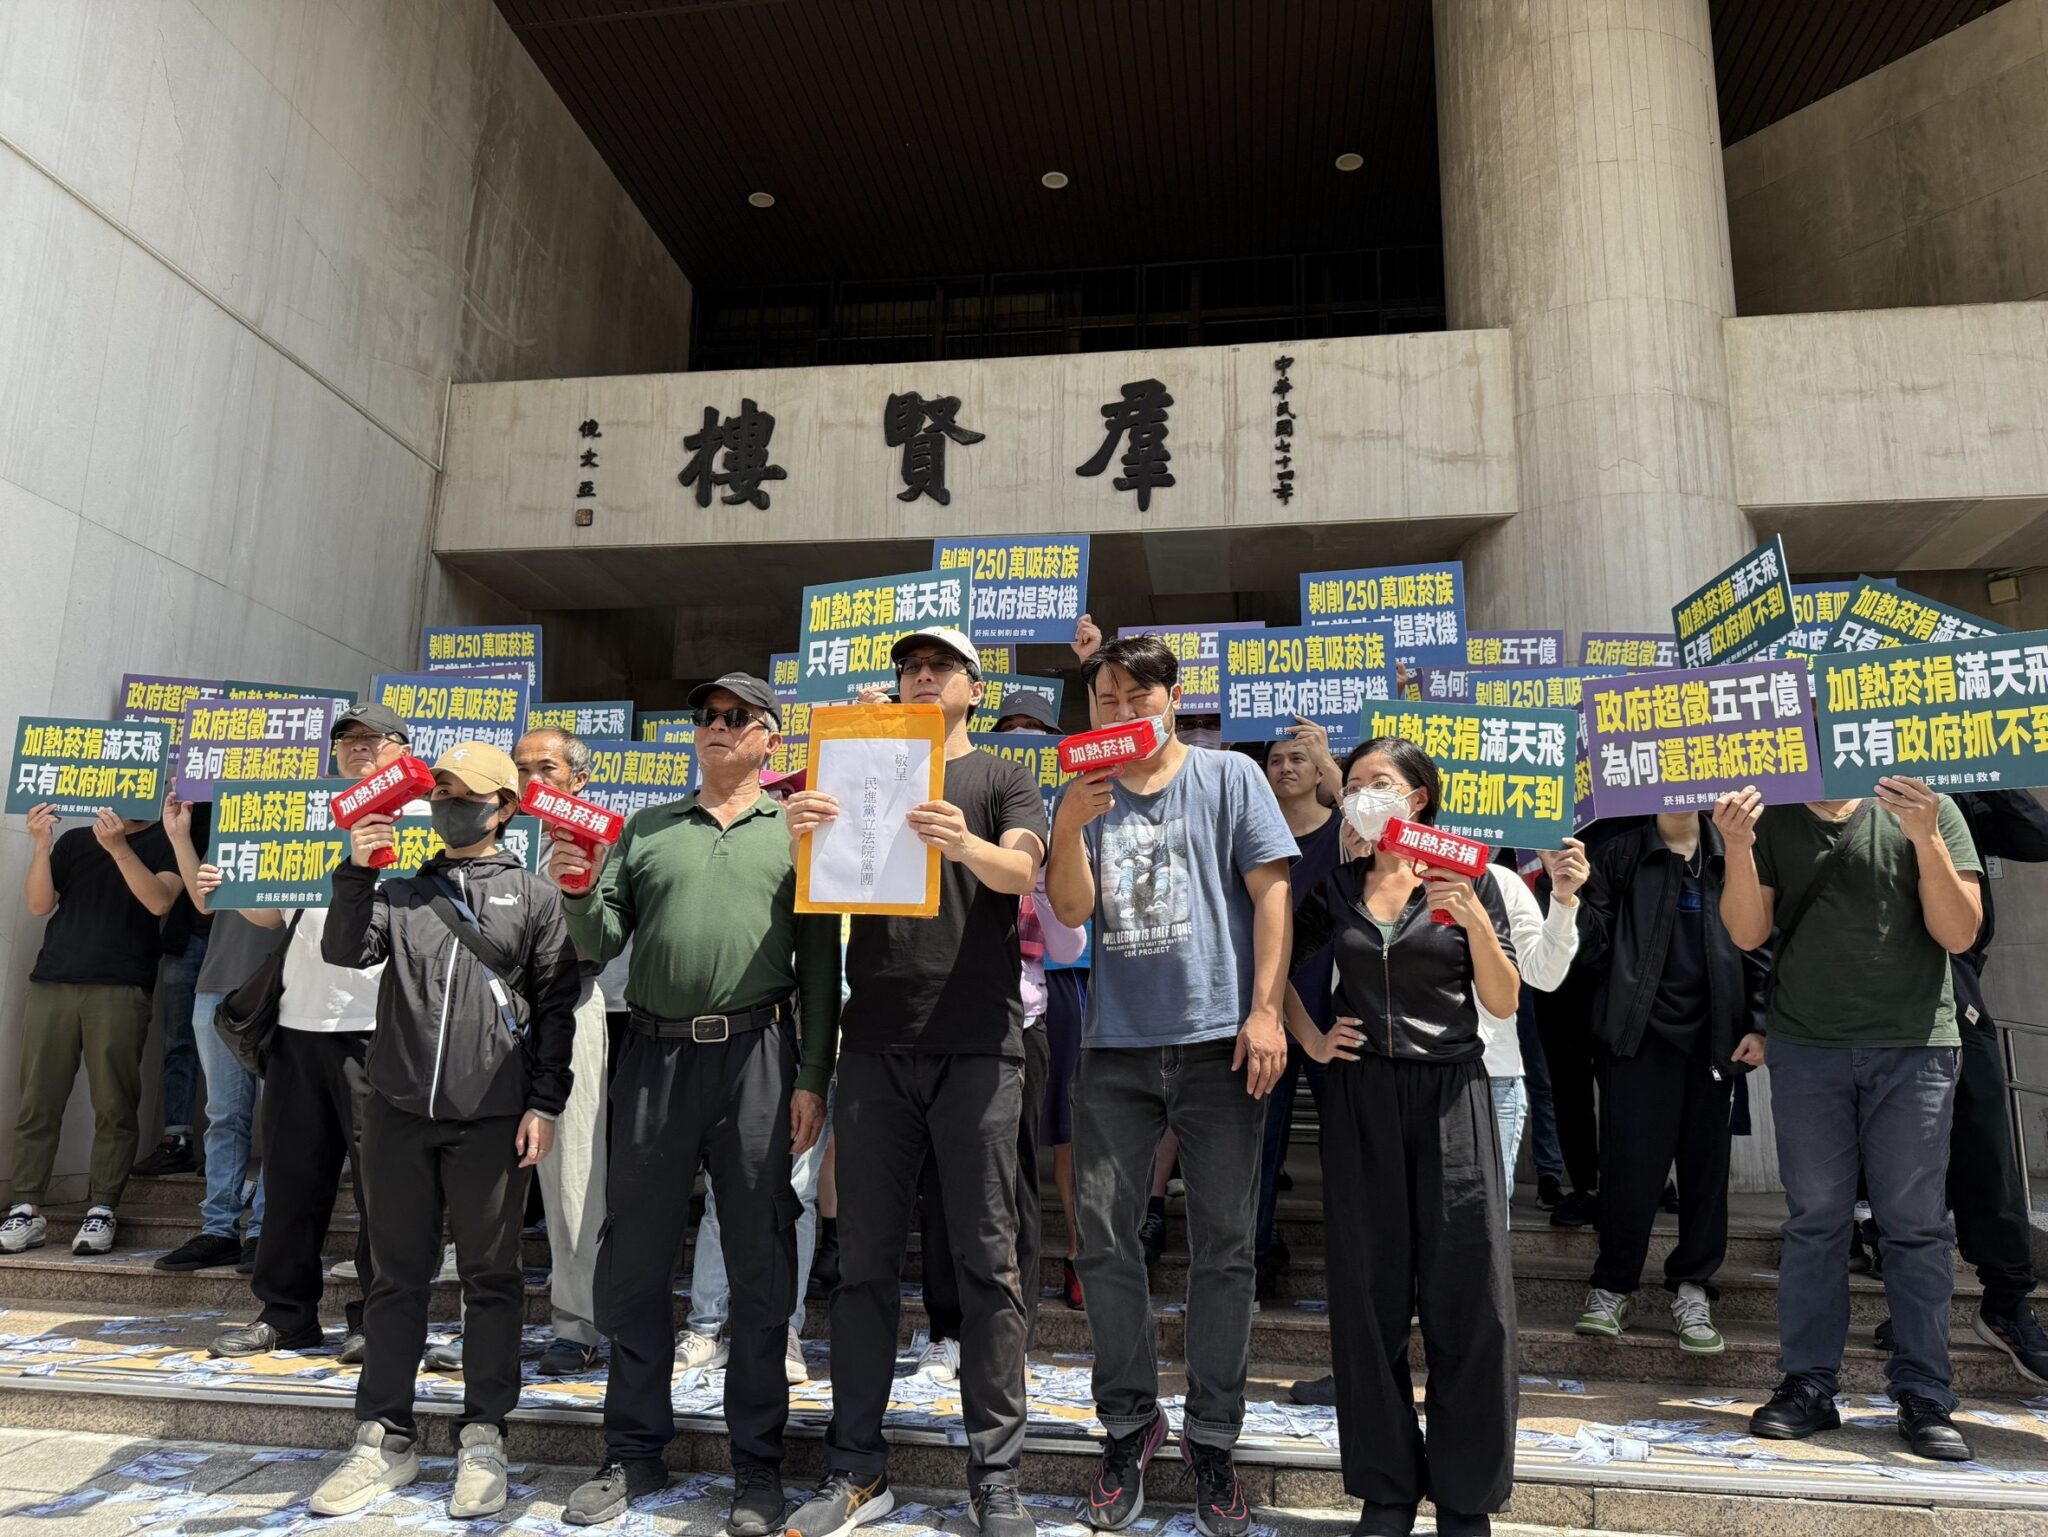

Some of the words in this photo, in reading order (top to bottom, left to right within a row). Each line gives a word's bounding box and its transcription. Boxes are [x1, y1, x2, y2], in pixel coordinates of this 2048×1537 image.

[1272, 355, 1297, 506] 中華民國七十四年
[576, 418, 603, 498] 倪文亞
[808, 578, 962, 633] 加熱菸捐滿天飛
[1308, 572, 1455, 615] 剝削250萬吸菸族
[1678, 548, 1780, 640] 加熱菸捐滿天飛
[1851, 584, 1999, 642] 加熱菸捐滿
[429, 632, 535, 660] 剝削250萬吸菸族
[1682, 582, 1786, 669] 只有政府抓不到
[805, 624, 960, 679] 只有政府
[1227, 632, 1385, 676] 剝削250萬吸菸族
[1466, 637, 1557, 665] 超徵五千億
[1585, 639, 1679, 668] 政府超徵五
[1229, 675, 1389, 719] 拒當政府提款機
[1429, 670, 1468, 698] 為何
[1826, 645, 2048, 713] 加熱菸捐滿天飛
[189, 706, 325, 741] 政府超徵五千億
[382, 683, 519, 722] 剝削250萬吸菸族
[1594, 671, 1802, 734] 政府超徵五千億
[21, 724, 162, 763] 加熱菸捐滿天飛
[1068, 735, 1136, 764] 加熱菸捐
[1371, 711, 1566, 767] 加熱菸捐滿天飛
[1600, 726, 1809, 788] 為何還漲紙菸捐
[16, 763, 158, 800] 只有政府抓不到
[185, 746, 320, 780] 為何還漲紙菸捐
[588, 749, 691, 787] 250萬吸菸族
[894, 753, 909, 781] 敬呈
[339, 765, 405, 816] 加熱菸捐
[531, 790, 610, 834] 加熱菸捐
[860, 777, 878, 886] 民進黨立法院黨團
[1399, 826, 1478, 867] 加熱菸捐
[1138, 946, 1170, 956] PROJECT
